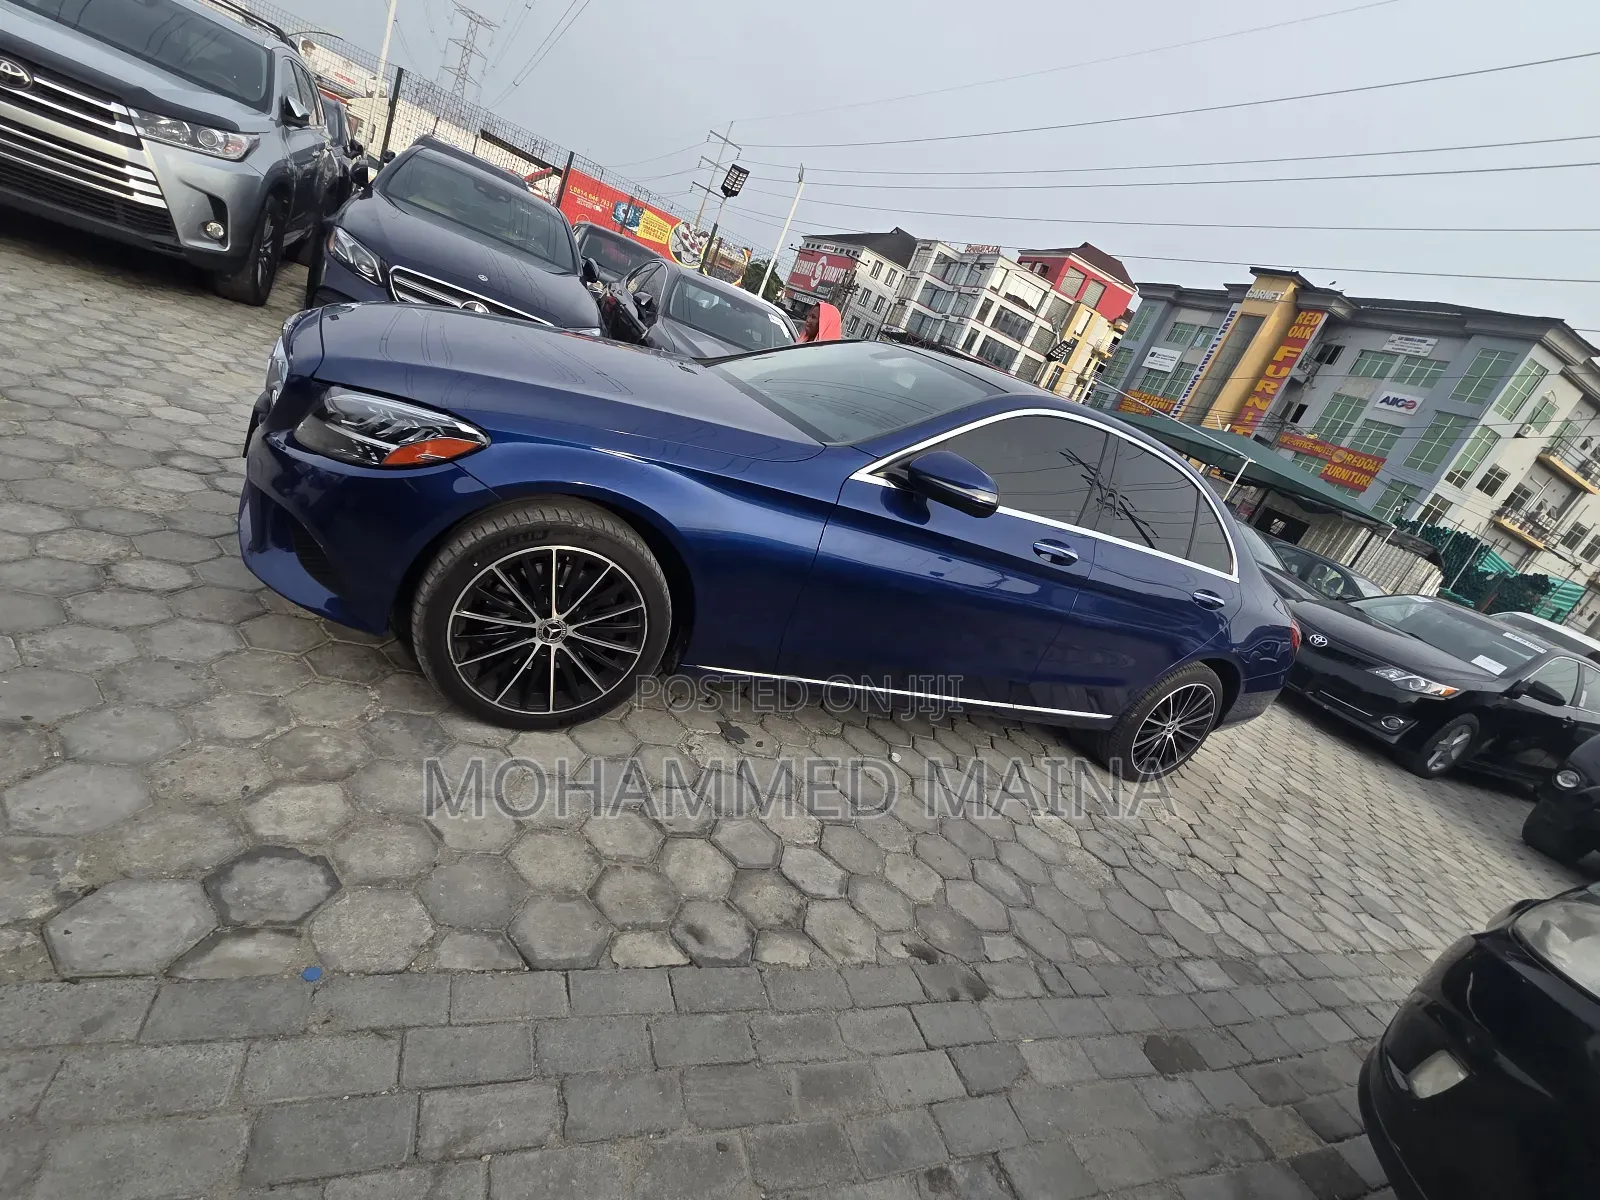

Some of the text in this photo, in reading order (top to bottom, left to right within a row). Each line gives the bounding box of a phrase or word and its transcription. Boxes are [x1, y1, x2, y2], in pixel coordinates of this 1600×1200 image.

[1246, 288, 1284, 301] GARNET
[1295, 311, 1322, 325] RED
[1288, 325, 1315, 340] OAK
[1379, 395, 1417, 410] AIICO
